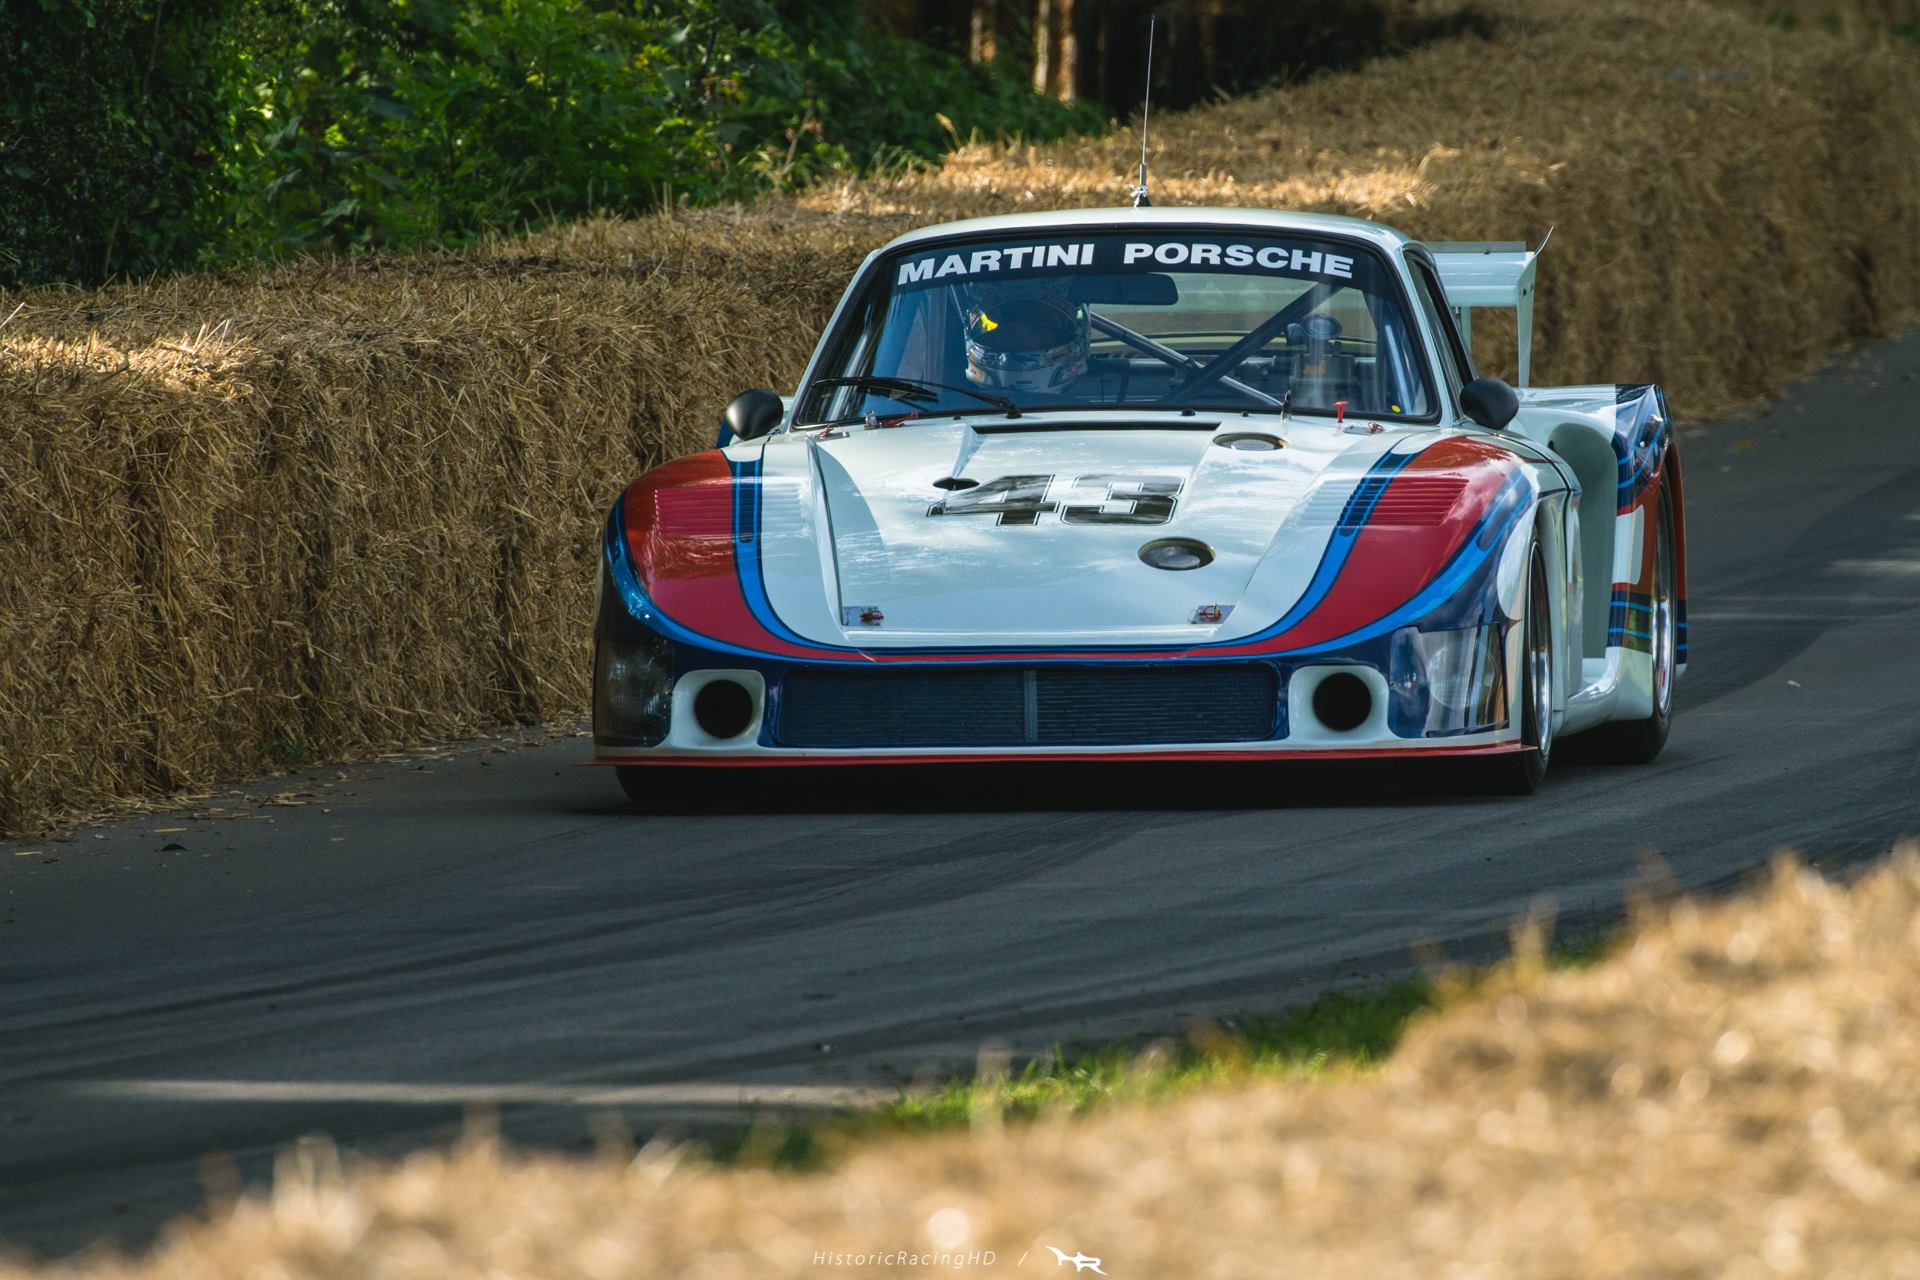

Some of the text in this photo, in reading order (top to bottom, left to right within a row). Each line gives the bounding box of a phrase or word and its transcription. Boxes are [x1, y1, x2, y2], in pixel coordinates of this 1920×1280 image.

[898, 242, 1354, 285] MARTINI PORSCHE
[926, 473, 1185, 526] 43
